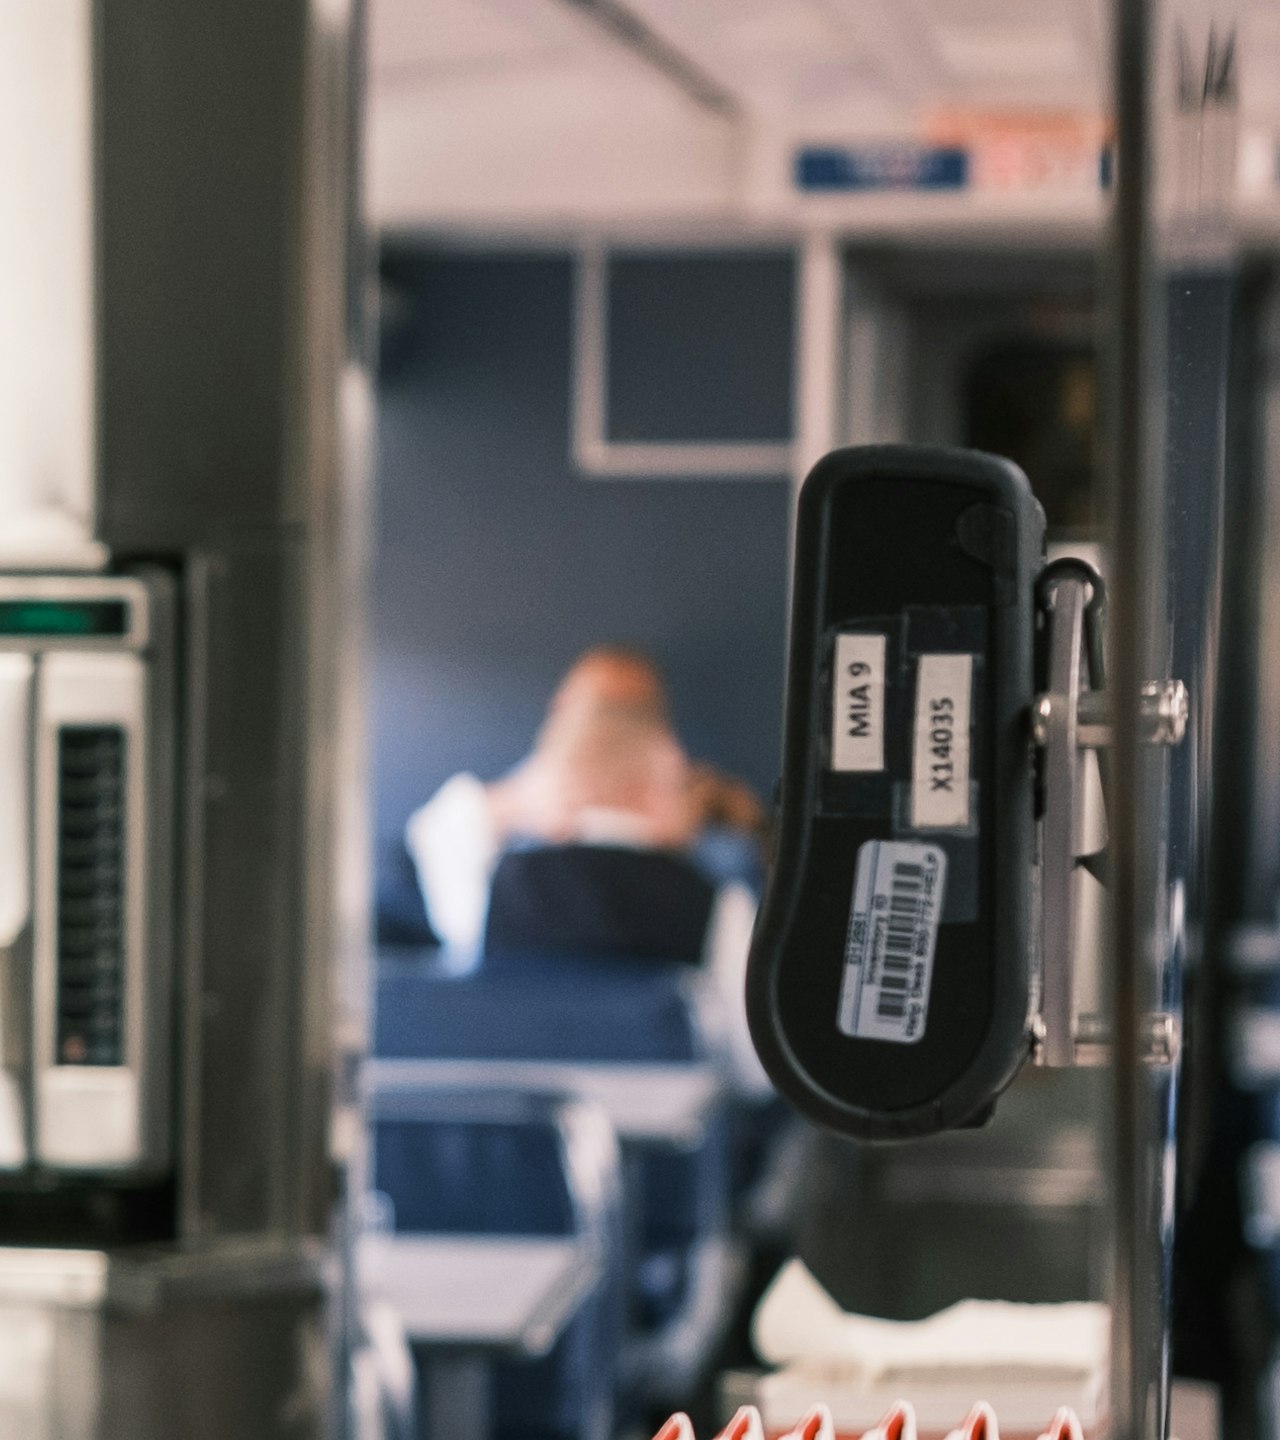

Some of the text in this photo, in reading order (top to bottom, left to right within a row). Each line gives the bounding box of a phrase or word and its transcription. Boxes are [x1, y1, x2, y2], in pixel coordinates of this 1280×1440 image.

[848, 661, 872, 738] MIA 9
[928, 696, 954, 793] X14035
